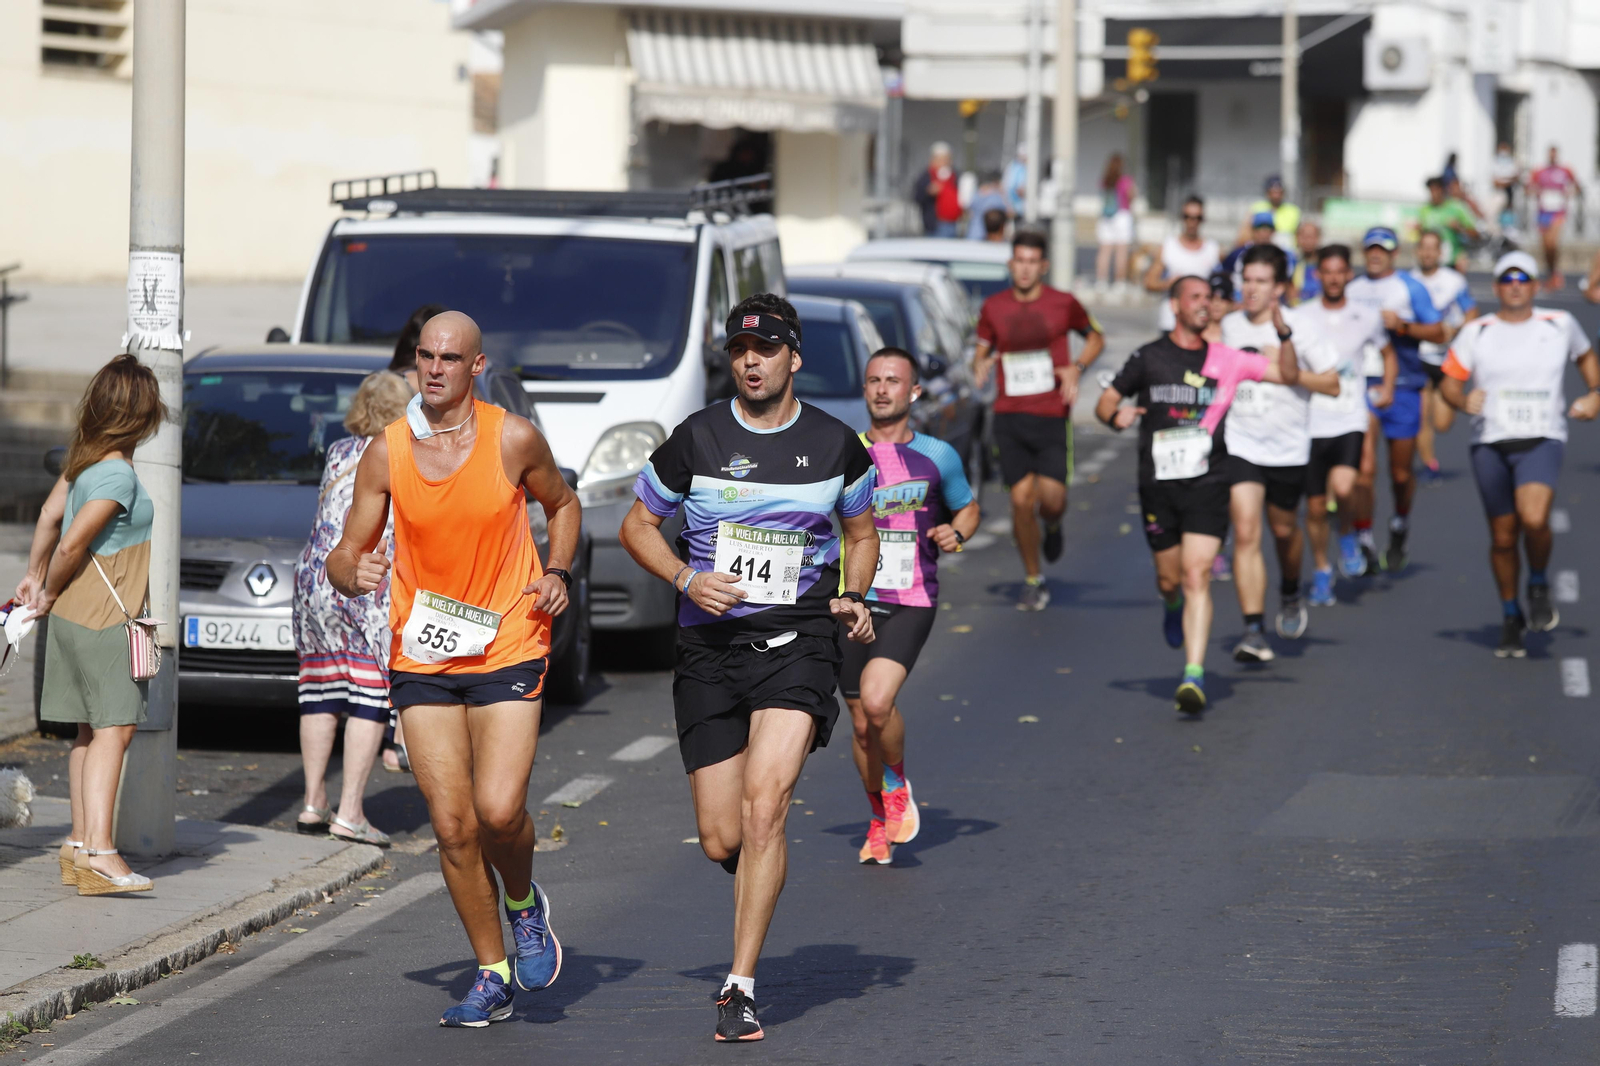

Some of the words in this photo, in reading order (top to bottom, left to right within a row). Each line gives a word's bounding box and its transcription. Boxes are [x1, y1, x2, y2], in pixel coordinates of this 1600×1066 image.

[724, 527, 734, 537] 34
[735, 528, 763, 542] VUELTA
[764, 534, 770, 543] A
[771, 533, 799, 544] HUELVA
[729, 540, 743, 548] LUIS
[743, 542, 773, 553] ALBERTO
[729, 554, 771, 583] 414
[420, 594, 431, 605] 34
[431, 597, 457, 615] VUELTA
[458, 606, 463, 617] A
[465, 608, 494, 626] HUELVA
[435, 611, 454, 622] DIEGO
[205, 621, 262, 645] 9244
[417, 622, 462, 653] 555
